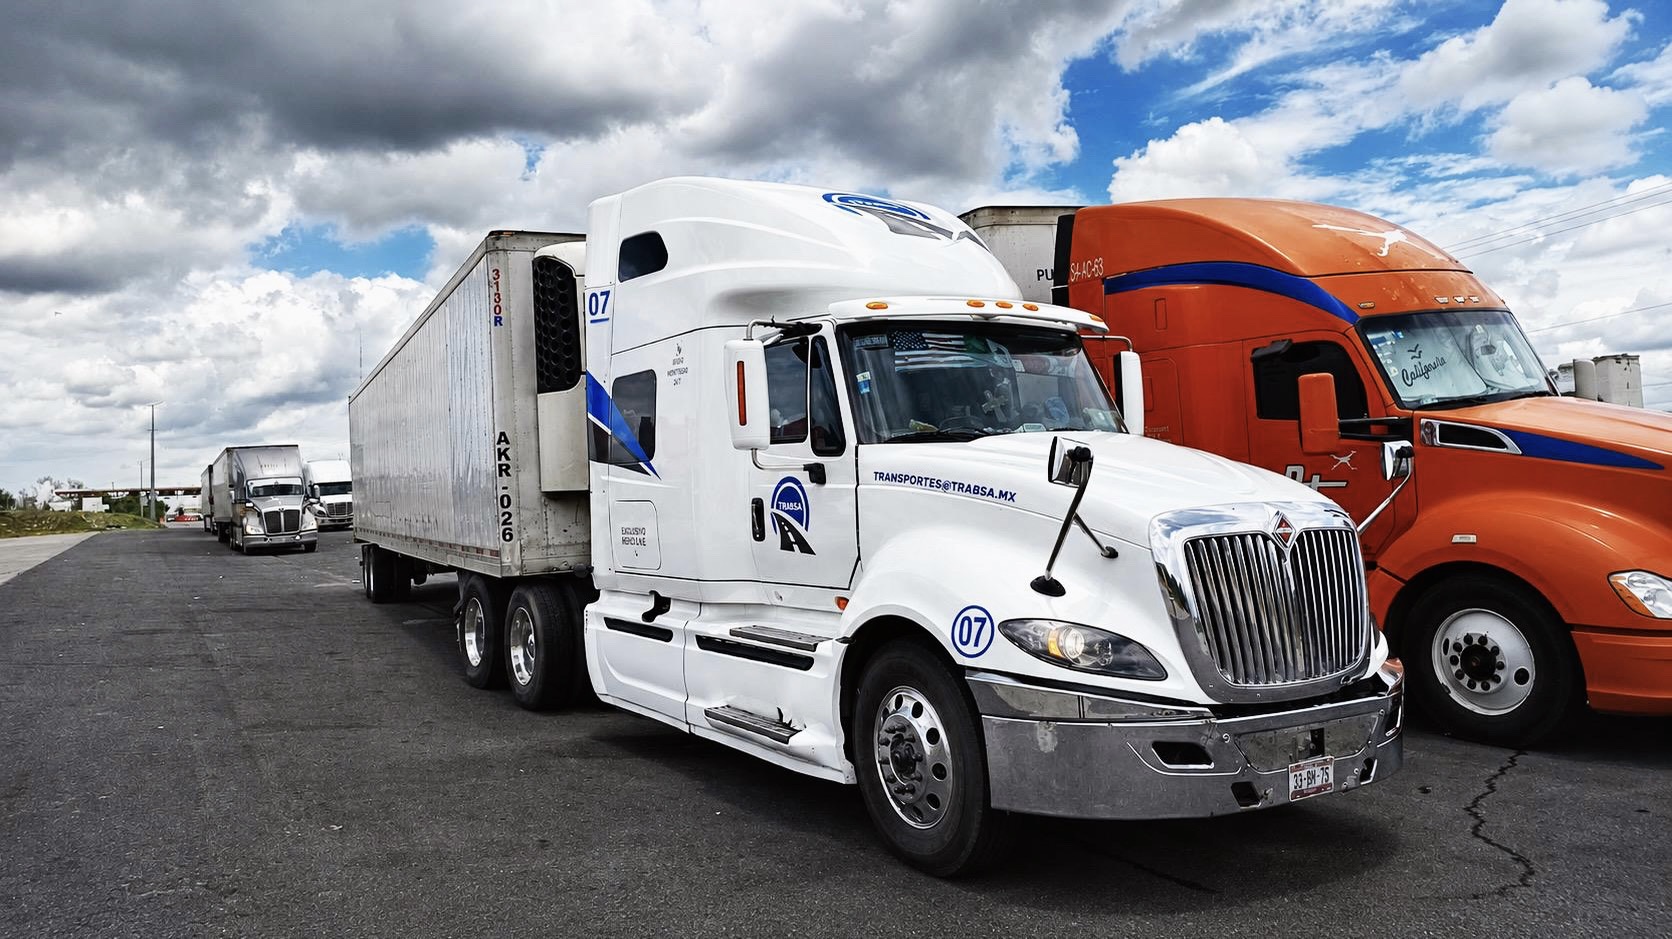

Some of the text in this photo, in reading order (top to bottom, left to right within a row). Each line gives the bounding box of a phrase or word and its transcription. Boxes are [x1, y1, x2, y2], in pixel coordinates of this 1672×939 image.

[1036, 268, 1054, 281] PU
[492, 268, 503, 326] 3130R
[588, 290, 610, 316] 07
[1402, 356, 1446, 387] California
[874, 471, 1016, 502] TRANSPORTES@TRABSA.MX
[778, 501, 803, 512] TRABSA
[958, 616, 987, 648] 07
